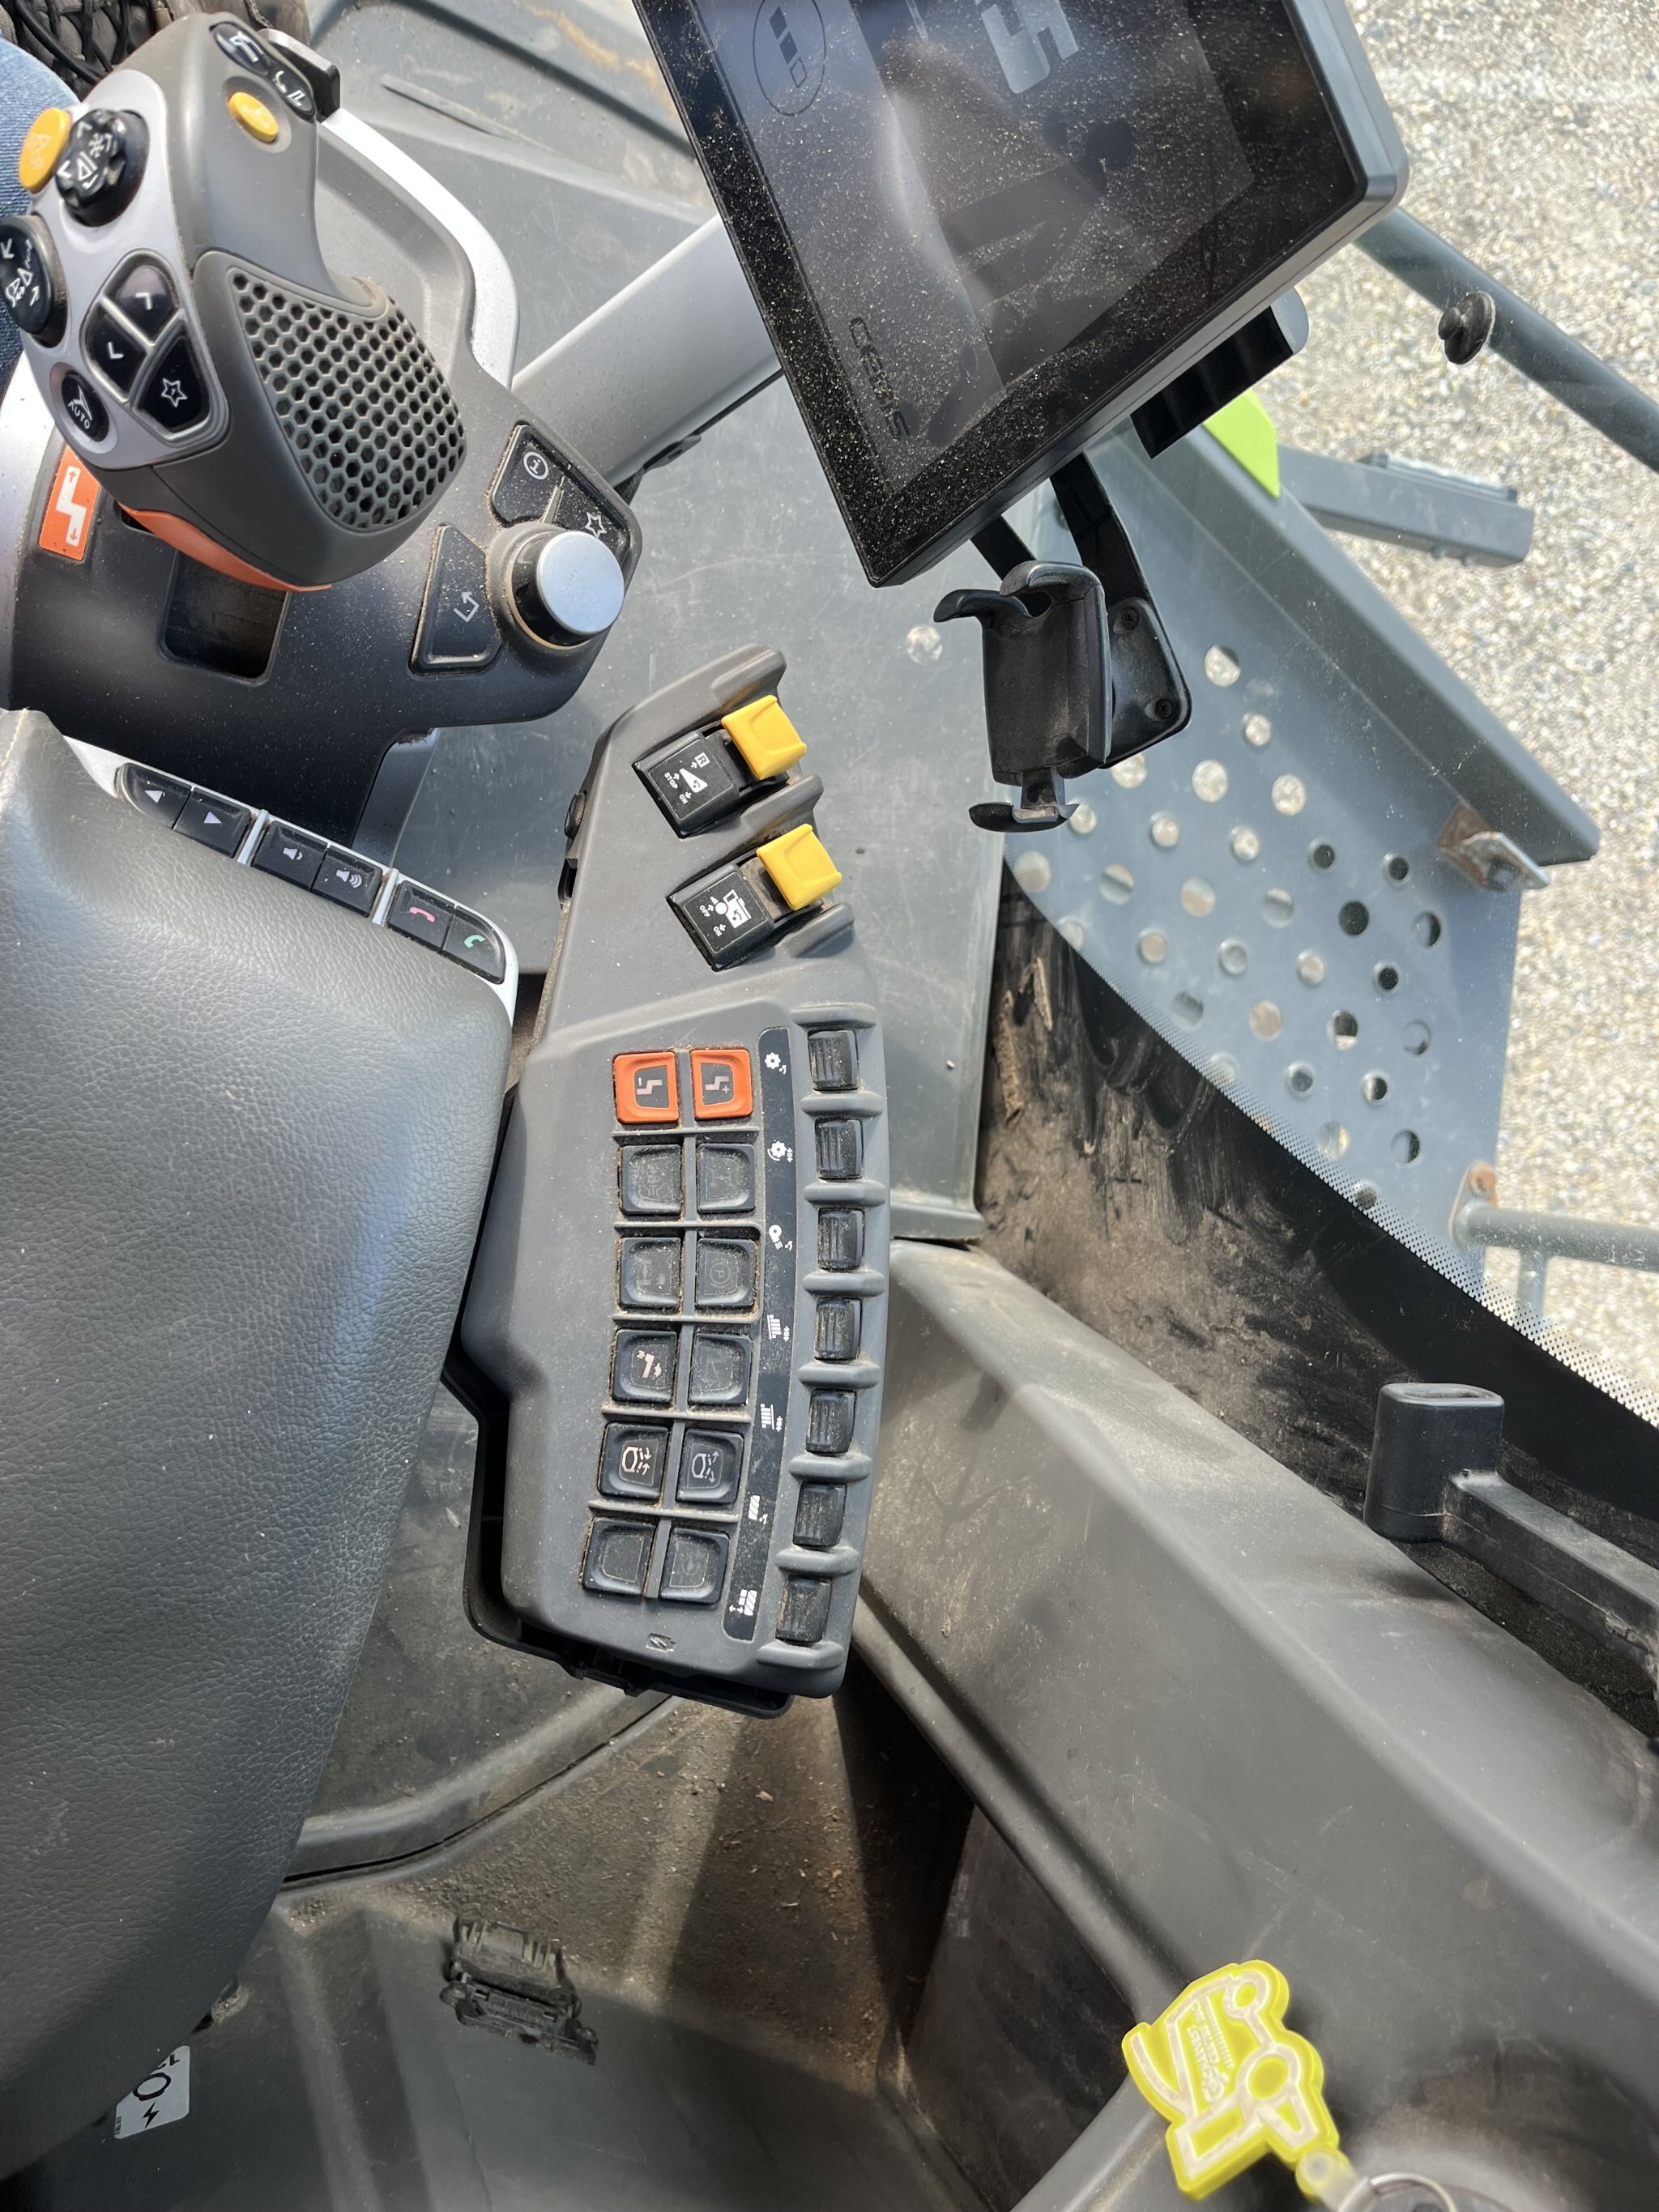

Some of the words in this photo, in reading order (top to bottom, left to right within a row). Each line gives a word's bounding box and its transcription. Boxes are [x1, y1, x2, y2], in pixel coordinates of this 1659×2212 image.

[67, 400, 91, 429] AUTO
[664, 772, 678, 789] STOP
[679, 794, 689, 804] ON
[699, 905, 711, 918] OFF
[713, 926, 723, 937] ON
